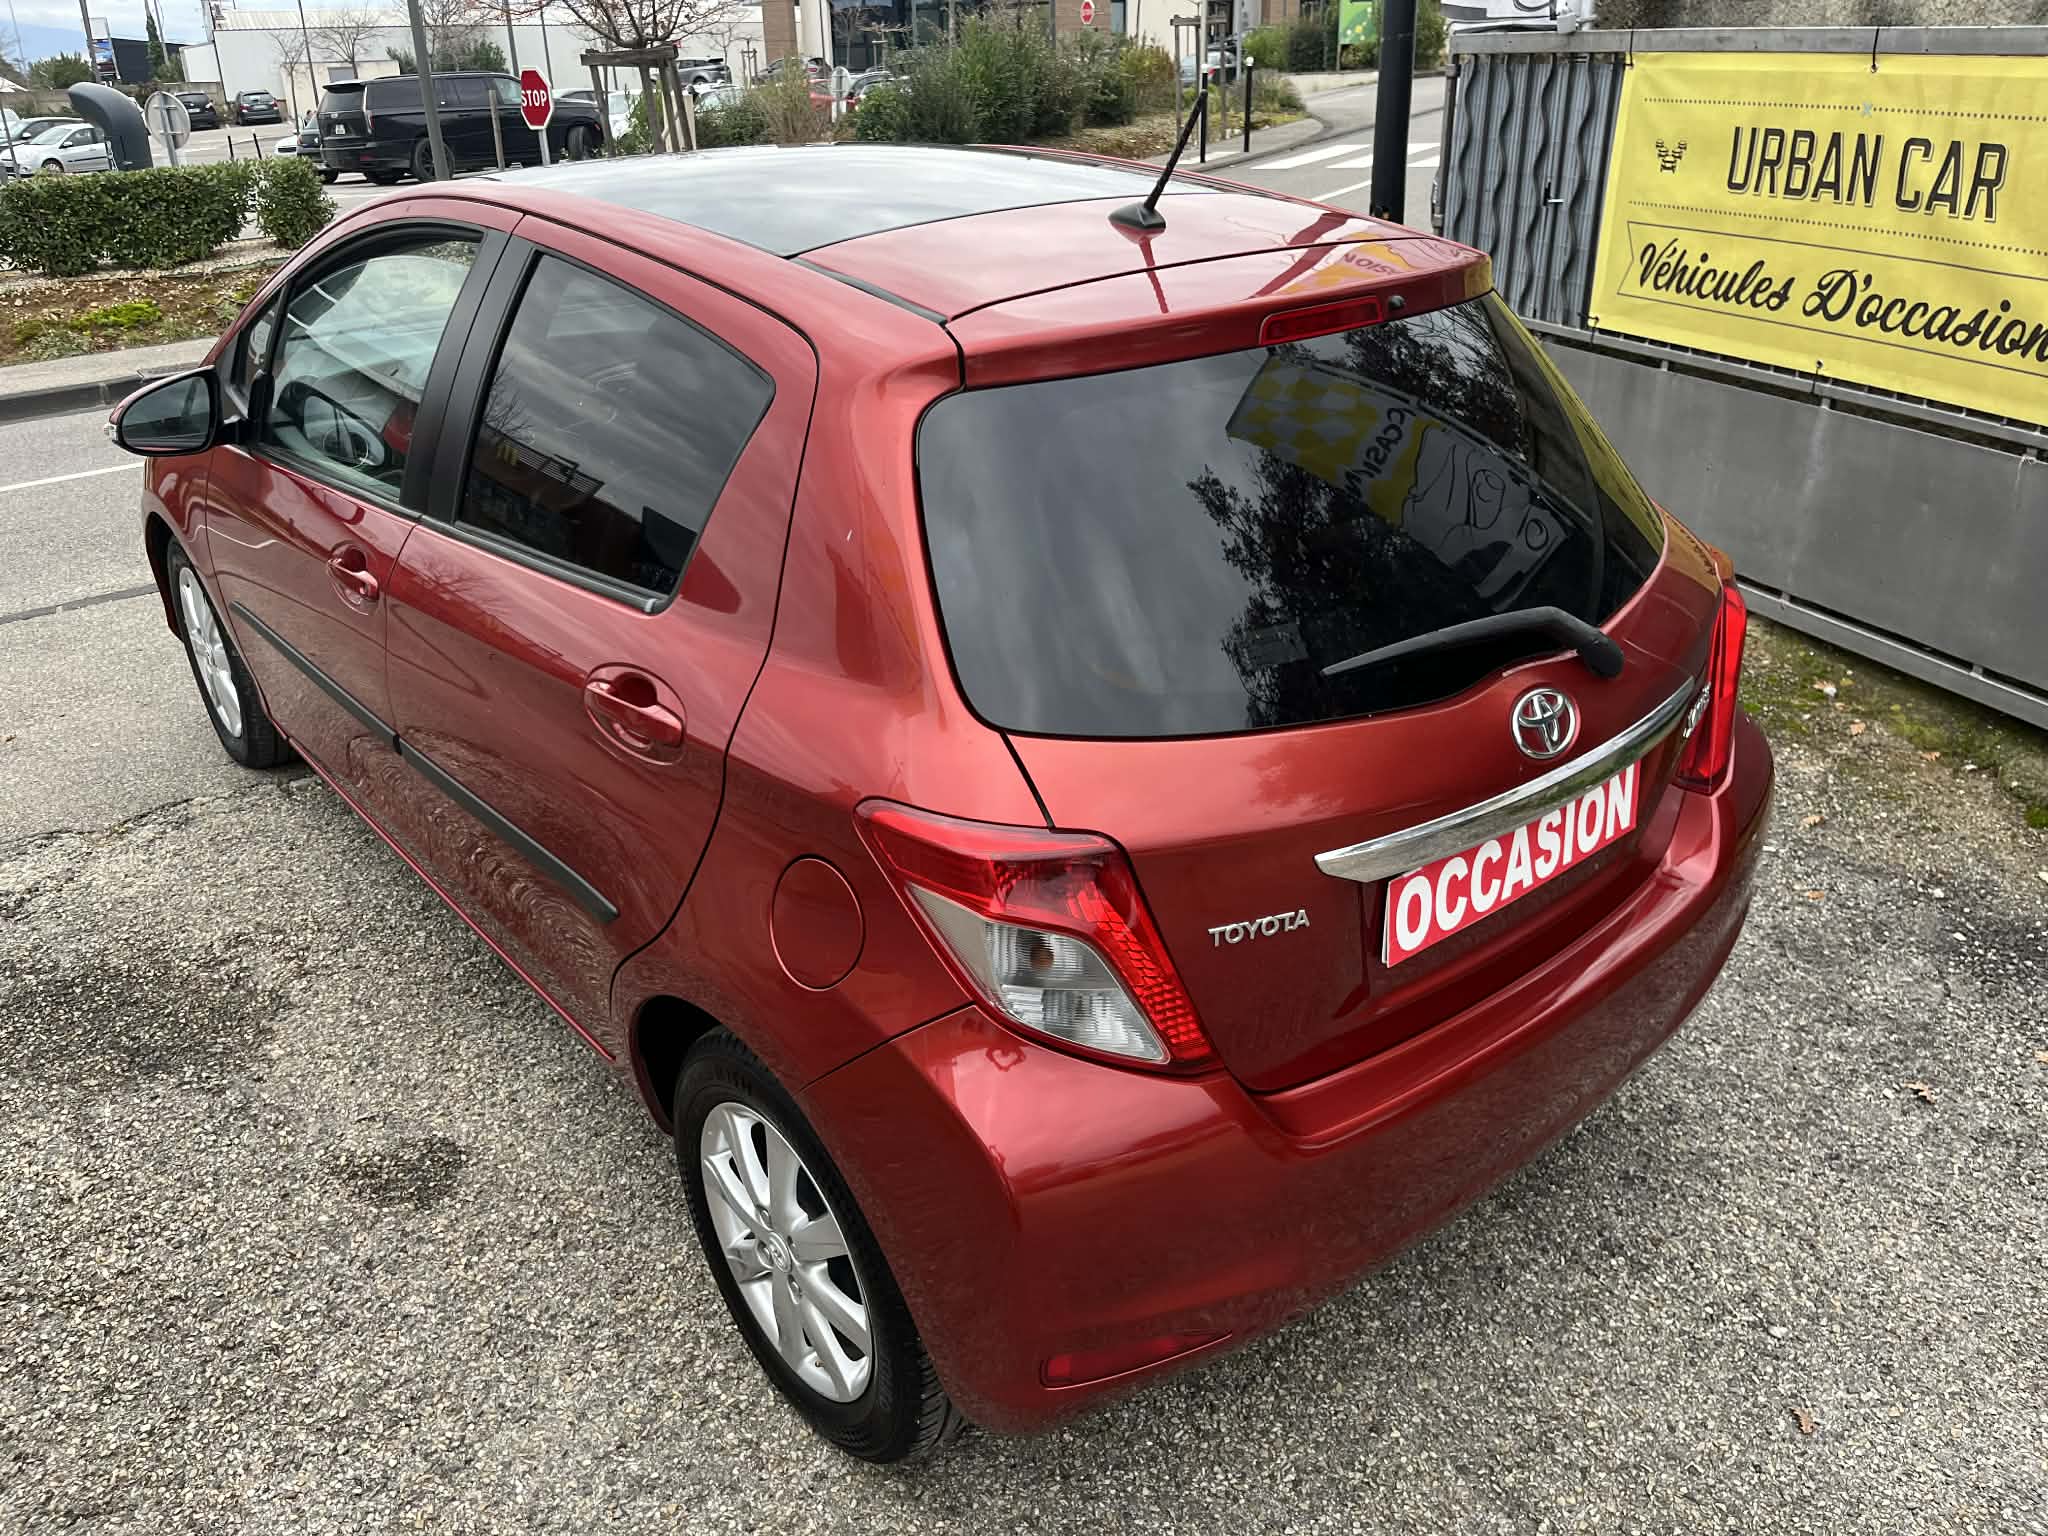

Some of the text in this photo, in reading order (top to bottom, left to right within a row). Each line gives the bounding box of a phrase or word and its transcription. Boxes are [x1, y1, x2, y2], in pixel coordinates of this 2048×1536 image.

[521, 90, 547, 106] STOP
[1728, 126, 2008, 222] URBAN CAR
[1639, 239, 2048, 361] Véhicules D'occasion
[1395, 764, 1636, 951] OCCASION
[1209, 909, 1310, 947] TOYOTA
